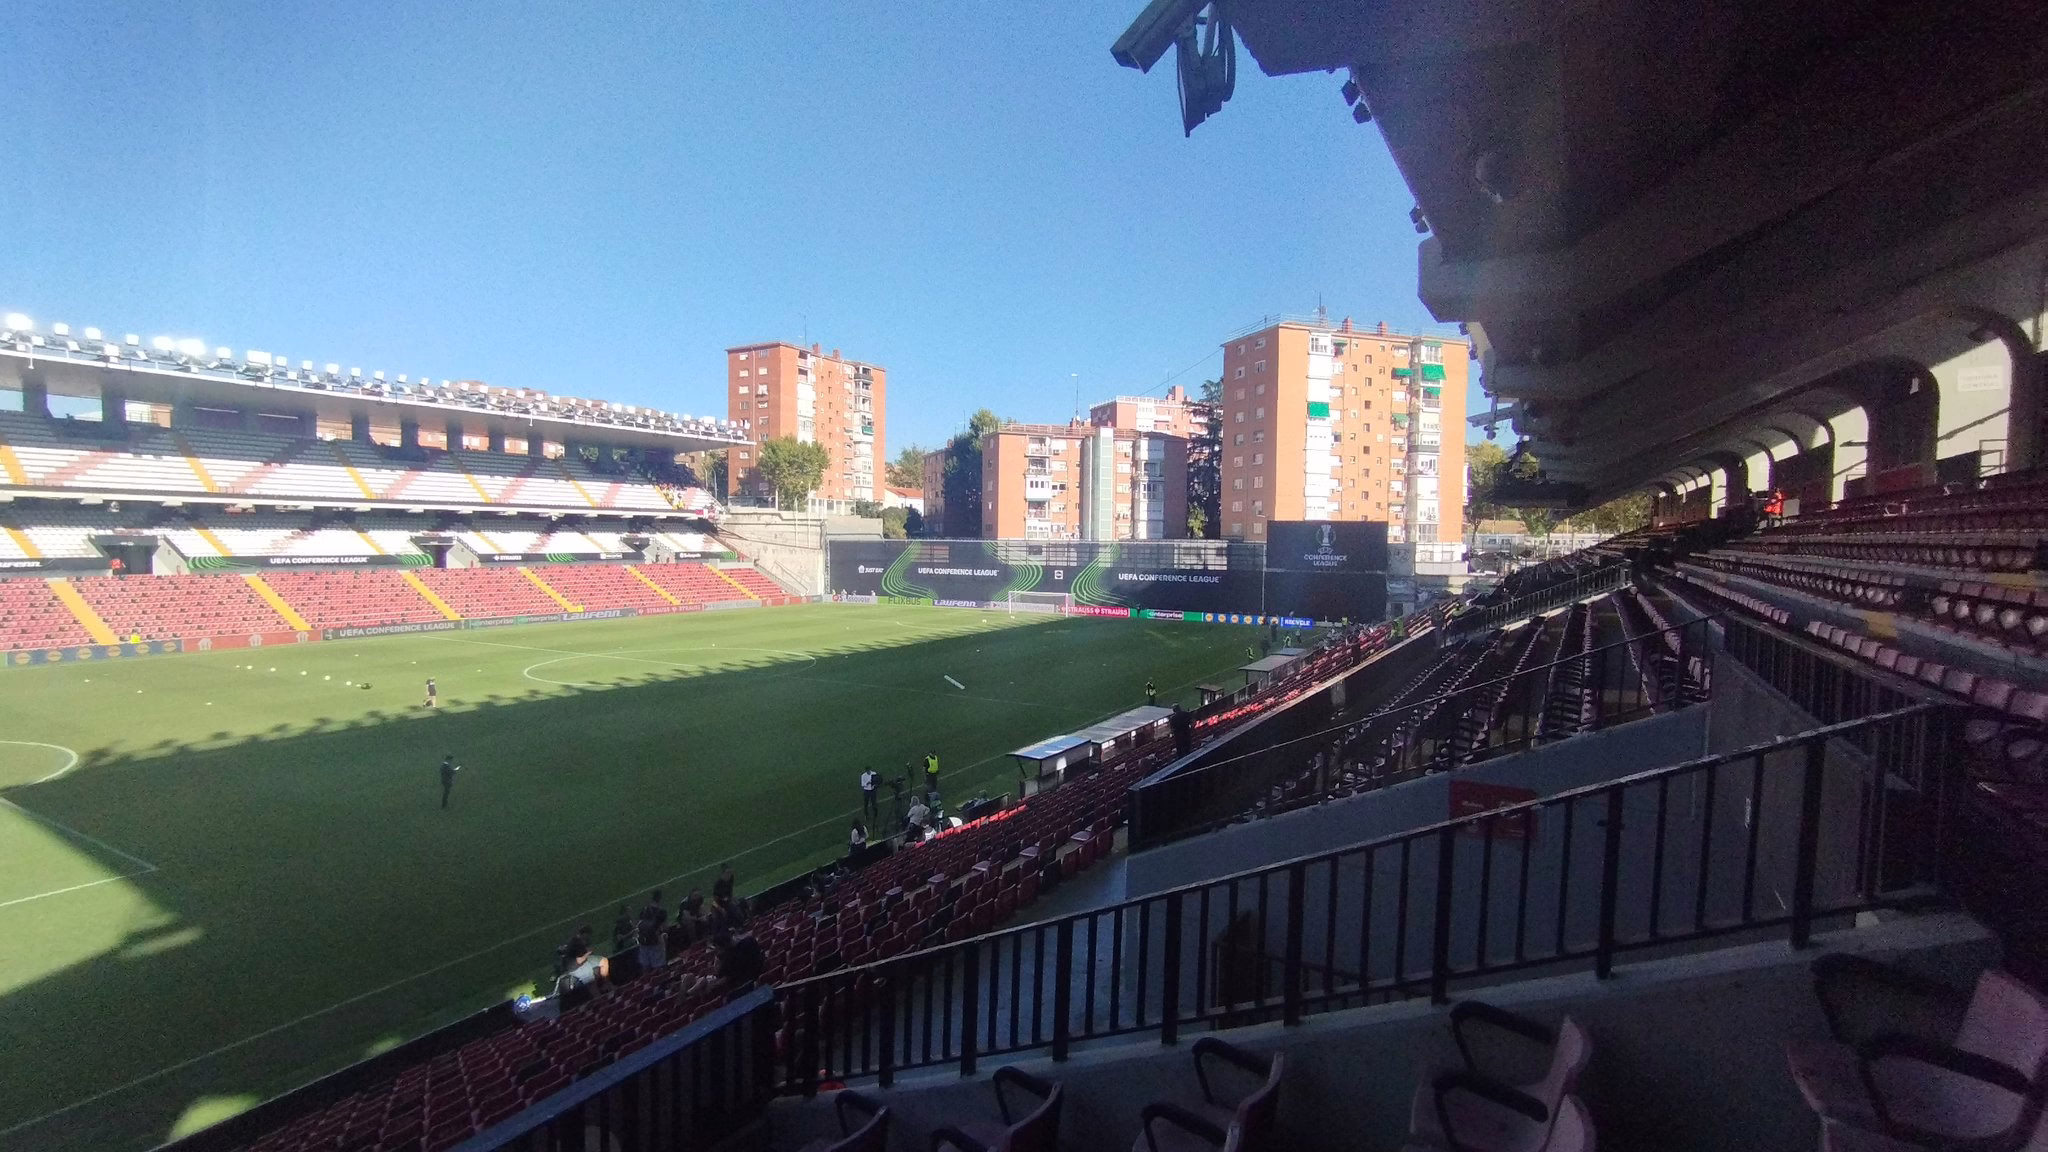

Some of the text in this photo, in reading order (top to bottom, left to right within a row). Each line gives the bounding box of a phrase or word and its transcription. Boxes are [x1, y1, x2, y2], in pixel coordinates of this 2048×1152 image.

[918, 567, 934, 575] UEFA
[934, 568, 973, 576] CONFERENCE
[1138, 574, 1188, 582] CONFERENCE
[888, 596, 921, 605] FLIXBUS
[1101, 607, 1128, 616] STRAUSS
[340, 622, 455, 637] UEFA CONFERENCE LEAGUE
